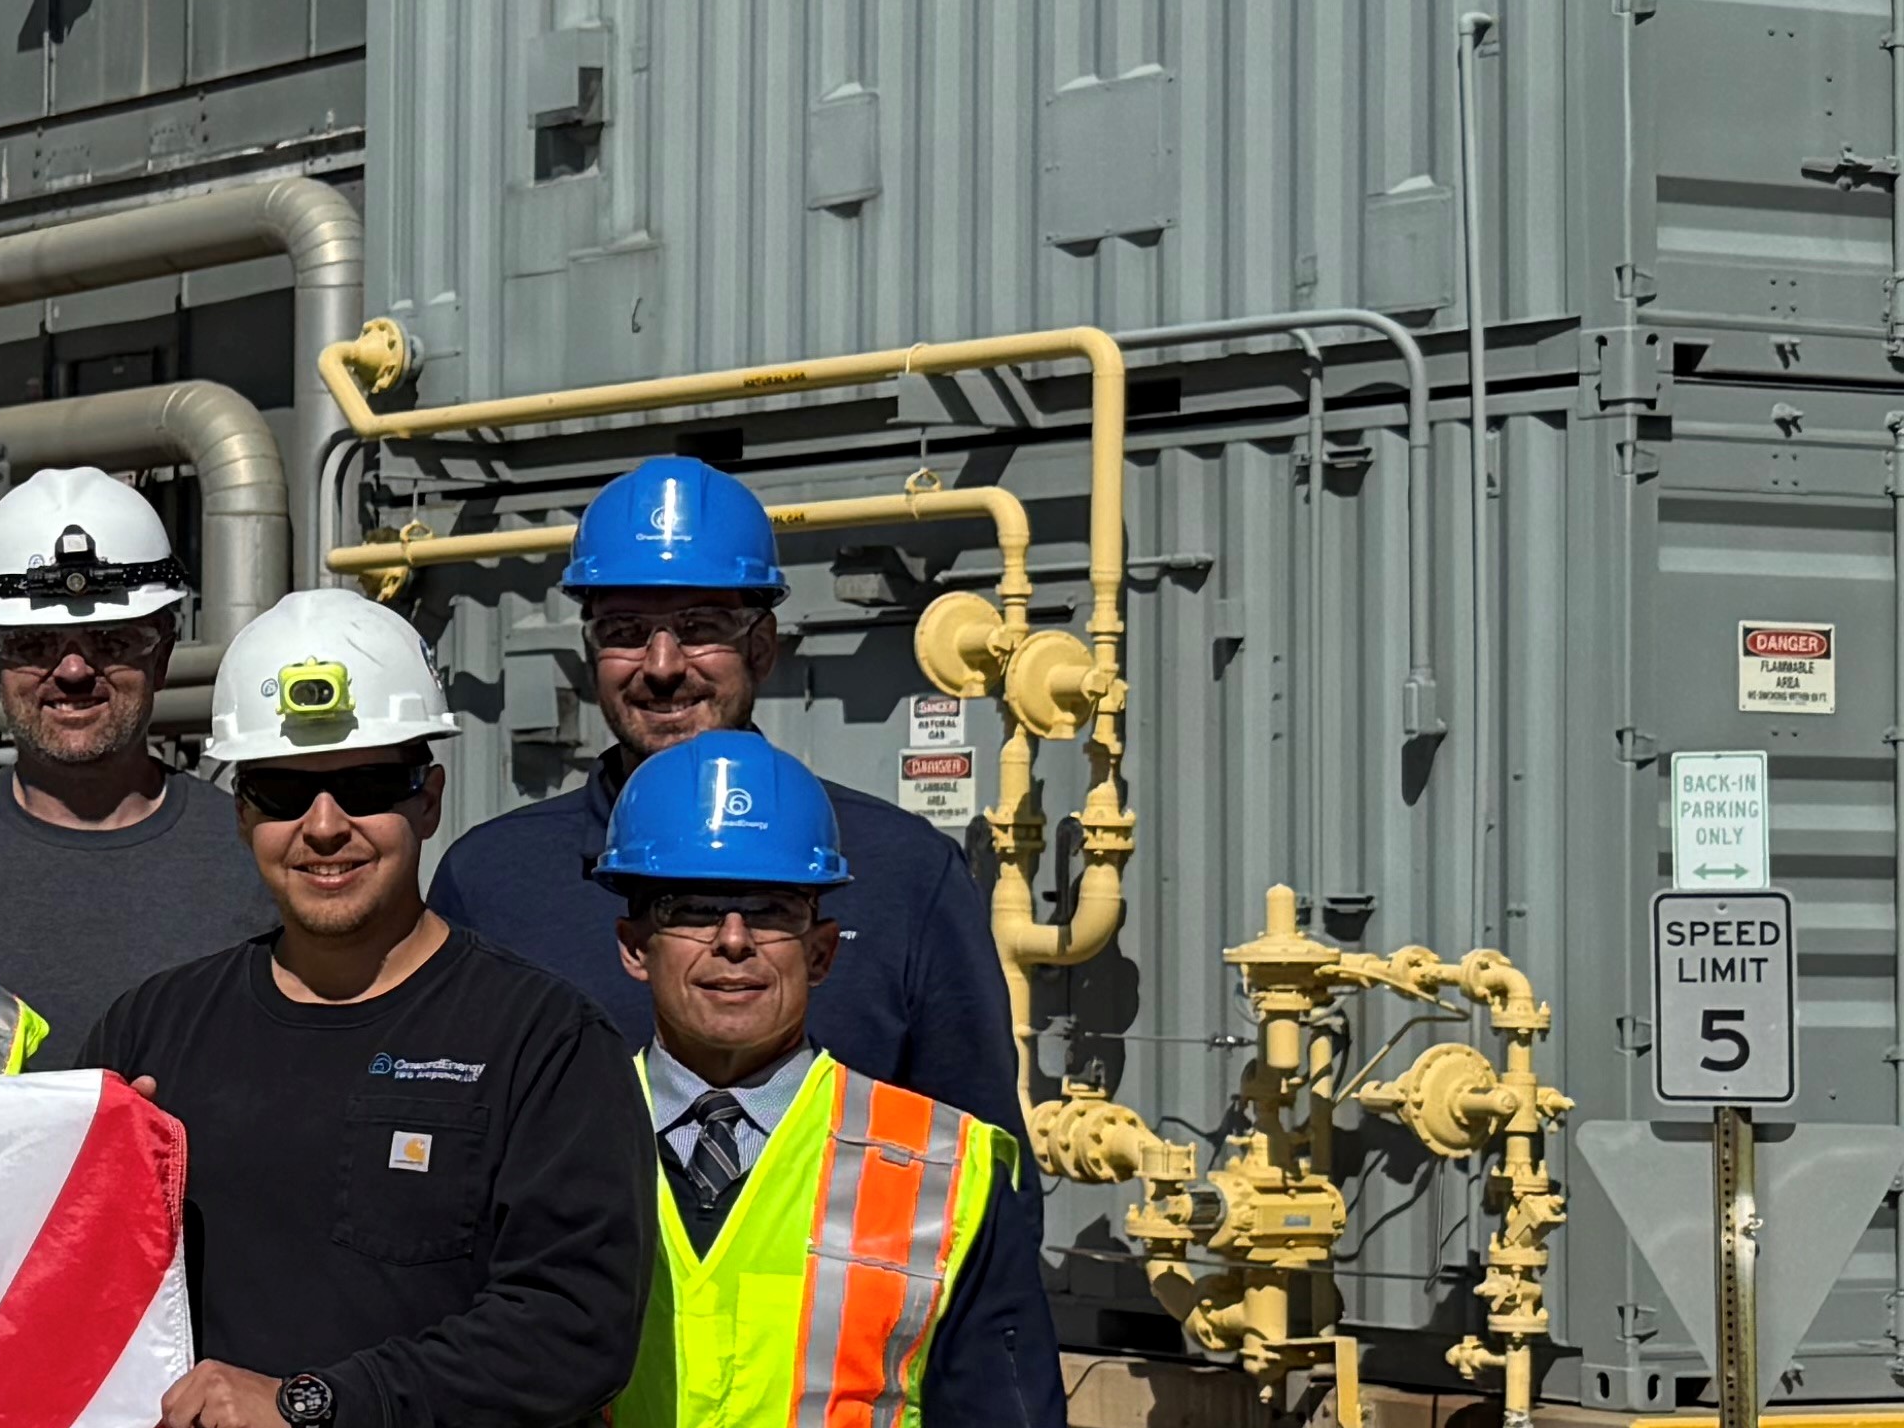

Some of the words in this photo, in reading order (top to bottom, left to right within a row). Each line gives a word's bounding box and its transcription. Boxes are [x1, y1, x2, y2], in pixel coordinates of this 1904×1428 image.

[1756, 634, 1819, 652] DANGER
[1682, 774, 1757, 794] BACK-IN
[1680, 800, 1760, 819] PARKING
[1695, 826, 1745, 846] ONLY
[1665, 920, 1781, 947] SPEED
[1677, 956, 1769, 984] LIMIT
[1699, 1008, 1751, 1073] 5
